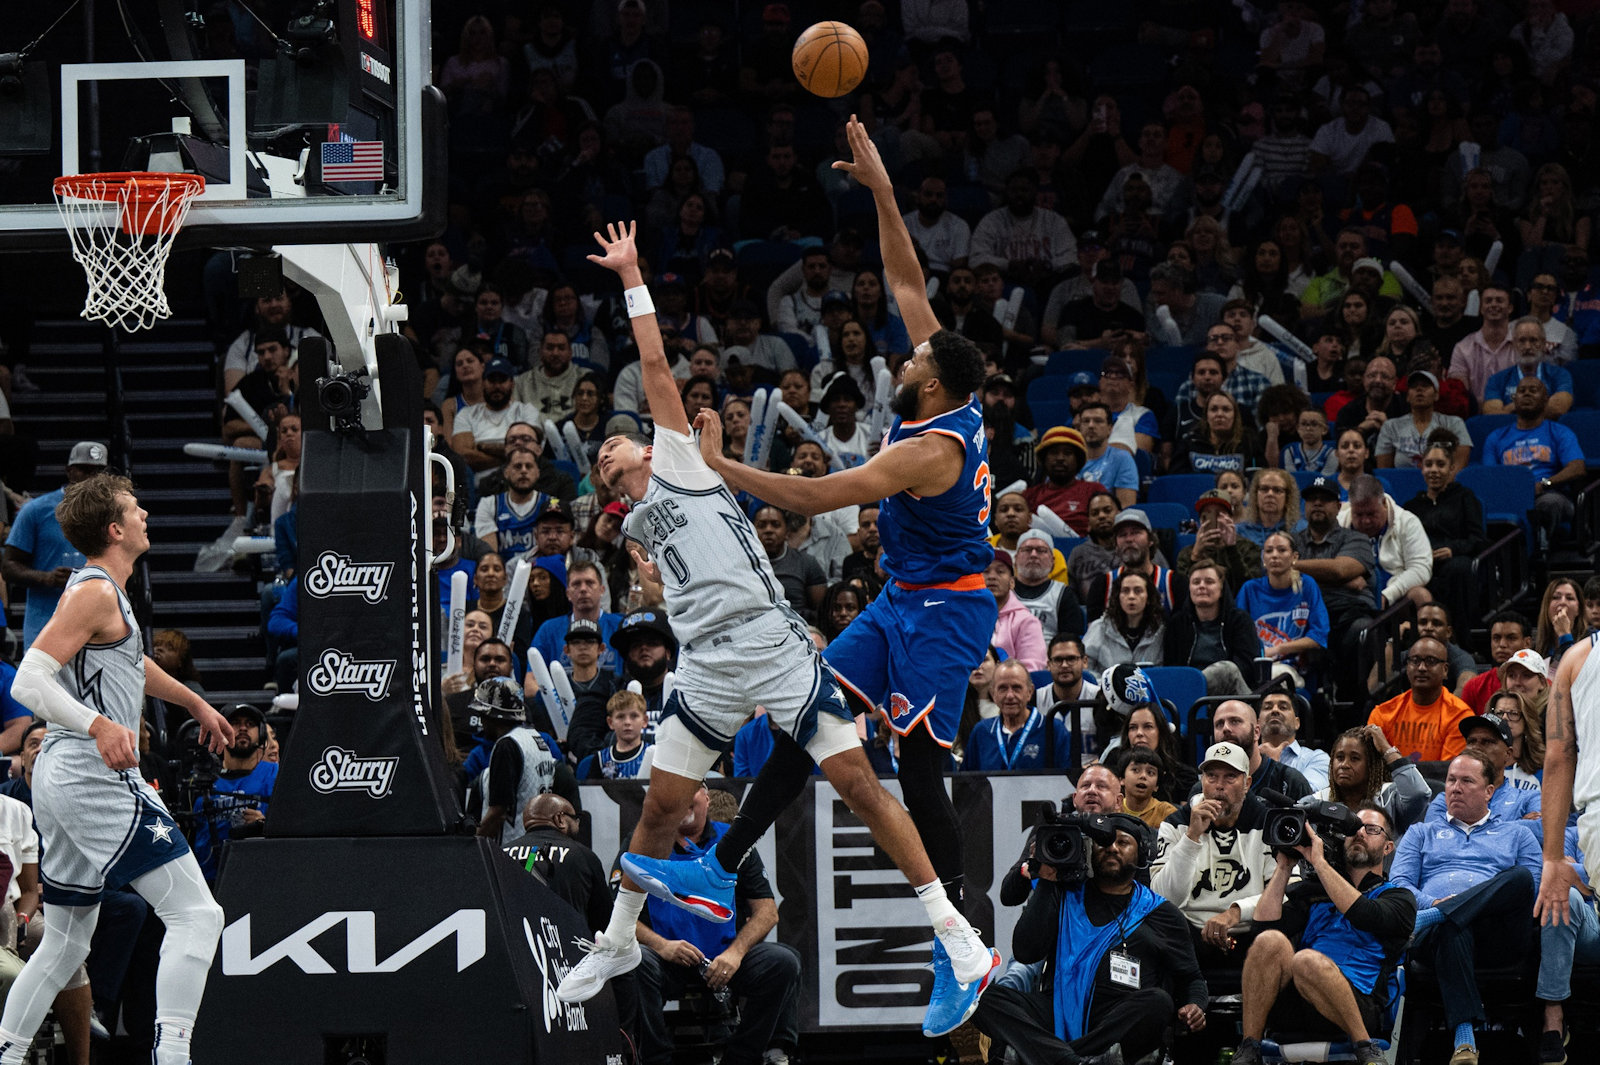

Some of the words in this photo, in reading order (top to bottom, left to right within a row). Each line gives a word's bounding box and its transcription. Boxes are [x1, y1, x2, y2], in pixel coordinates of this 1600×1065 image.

[304, 550, 395, 604] Starry
[662, 543, 691, 588] 0
[409, 490, 429, 737] AdventHealth
[307, 648, 398, 702] Starry
[309, 746, 400, 799] Starry
[540, 916, 563, 958] City
[835, 925, 937, 1009] ON
[564, 1001, 588, 1032] Bank
